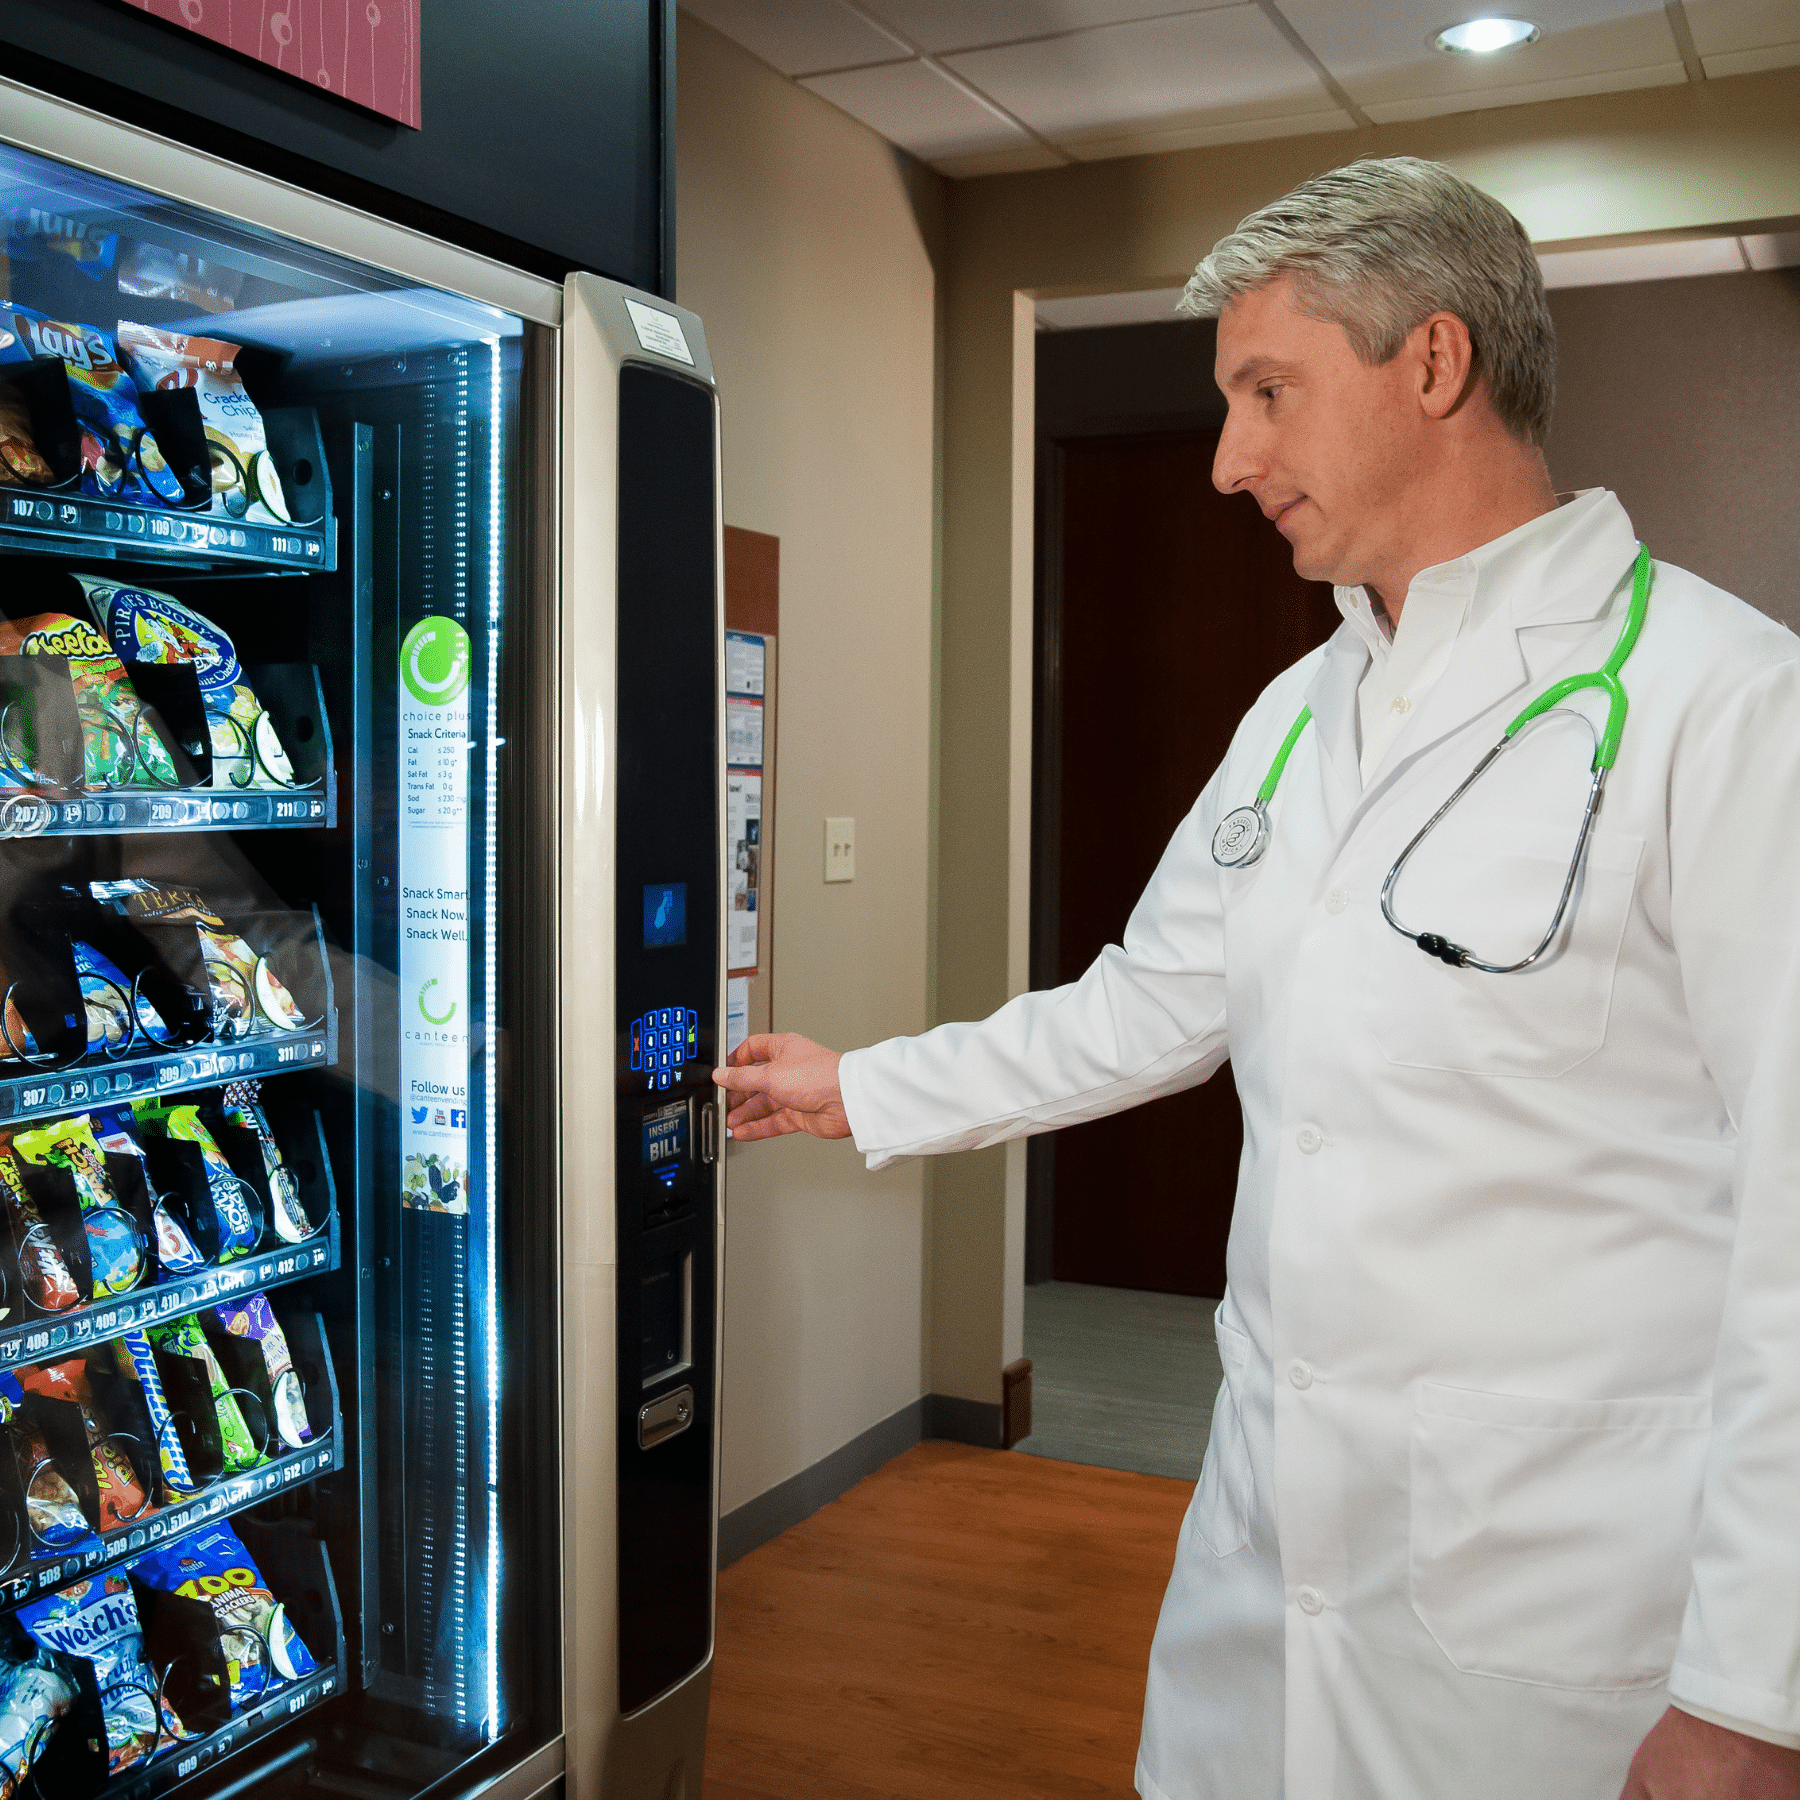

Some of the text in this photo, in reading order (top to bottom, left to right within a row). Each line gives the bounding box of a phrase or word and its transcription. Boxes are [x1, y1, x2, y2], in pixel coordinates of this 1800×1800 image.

[203, 391, 250, 405] Cracke
[13, 499, 34, 517] 107
[151, 519, 170, 536] 109
[272, 537, 287, 552] 111
[403, 711, 471, 724] choice plus
[407, 728, 466, 739] Snack Criteria
[15, 806, 38, 823] 207
[152, 804, 171, 820] 209
[277, 803, 292, 817] 211
[403, 887, 434, 899] Snack
[406, 908, 438, 919] Snack
[406, 928, 438, 940] Snack
[278, 1046, 293, 1062] 311
[160, 1066, 179, 1083] 309
[411, 1080, 466, 1096] Follow us
[23, 1088, 46, 1107] 307
[649, 1118, 679, 1139] INSERT
[650, 1135, 681, 1162] BILL
[26, 1332, 49, 1351] 408
[96, 1312, 116, 1330] 409
[161, 1293, 179, 1310] 410
[278, 1258, 294, 1275] 412
[39, 1566, 61, 1588] 508
[106, 1537, 127, 1559] 509
[170, 1511, 189, 1529] 510
[284, 1464, 300, 1482] 512
[210, 1586, 251, 1609] ANIMAL
[214, 1594, 256, 1618] CRACKERS
[41, 1598, 138, 1654] Welch's
[289, 1693, 305, 1713] 611
[178, 1756, 197, 1777] 609
